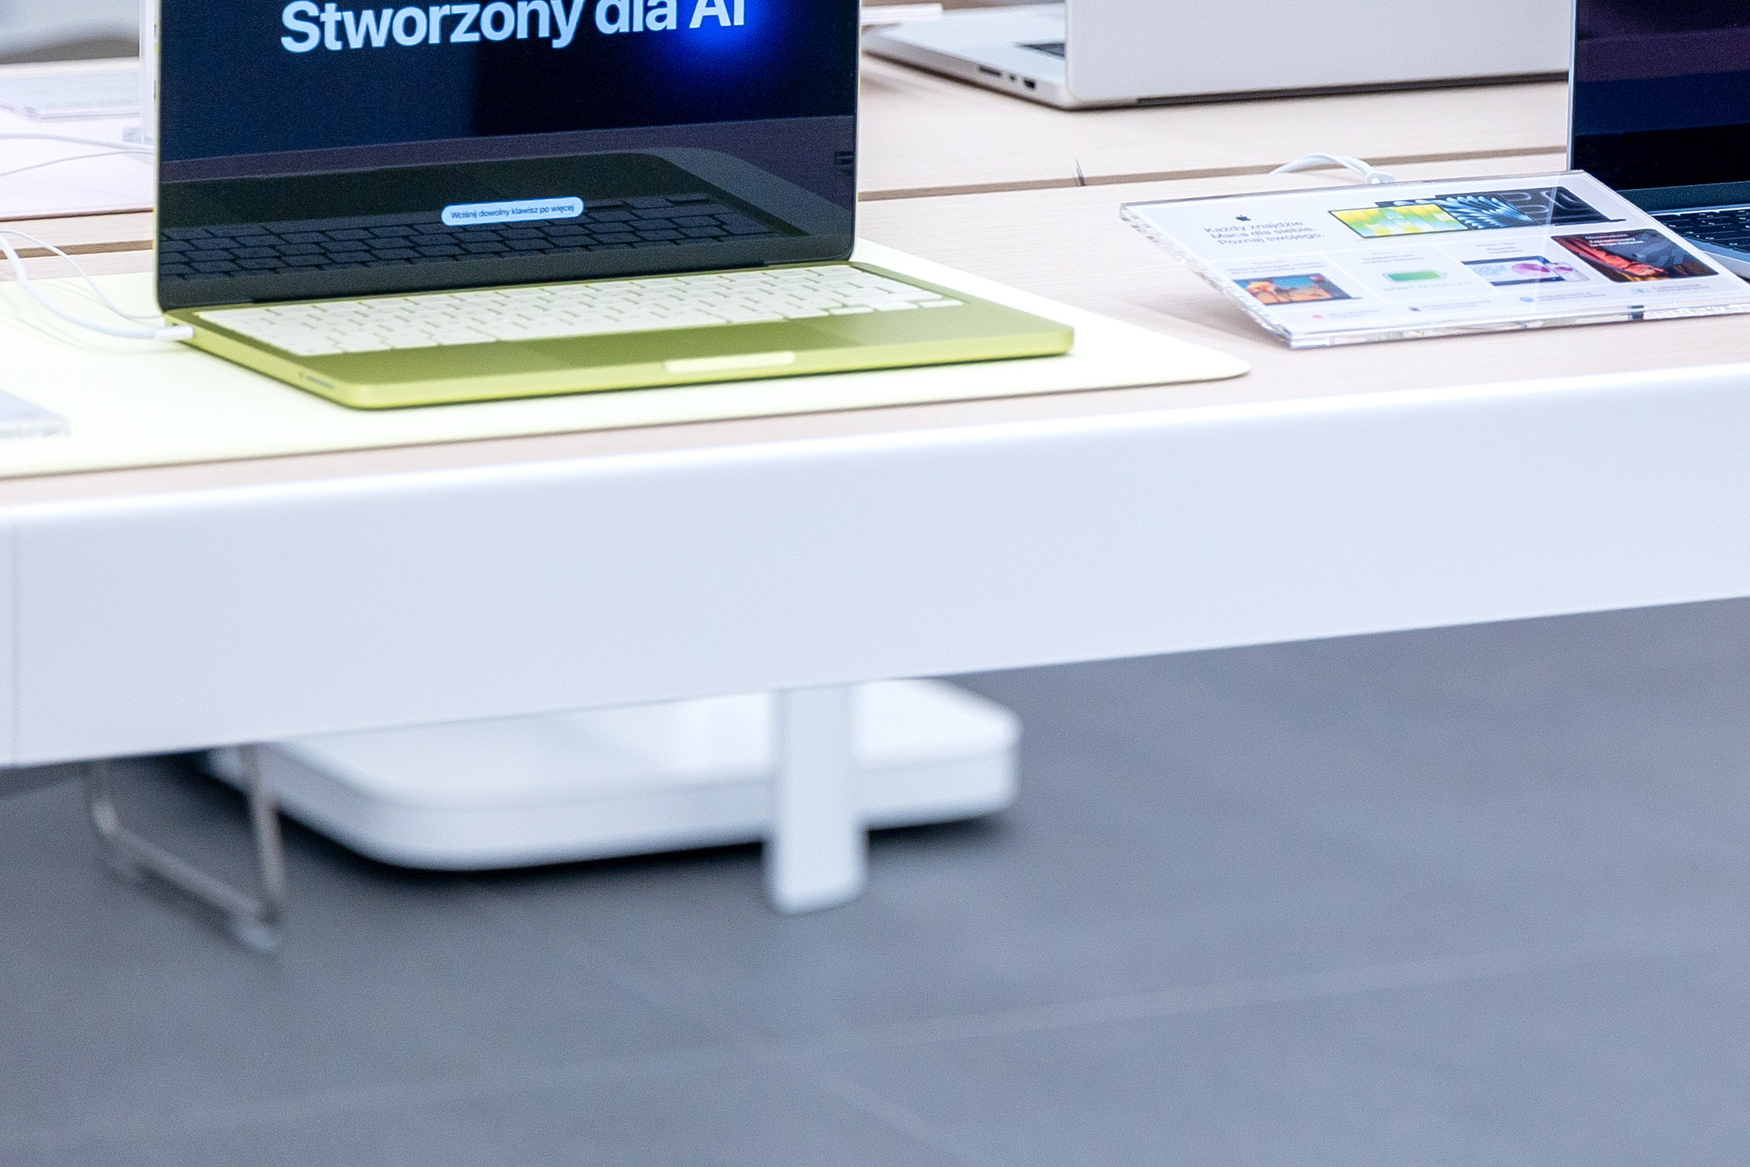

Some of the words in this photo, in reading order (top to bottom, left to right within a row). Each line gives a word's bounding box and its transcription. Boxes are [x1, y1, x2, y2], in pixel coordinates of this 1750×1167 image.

[478, 208, 510, 218] dowolny
[511, 206, 538, 215] klawisz
[539, 206, 550, 214] po
